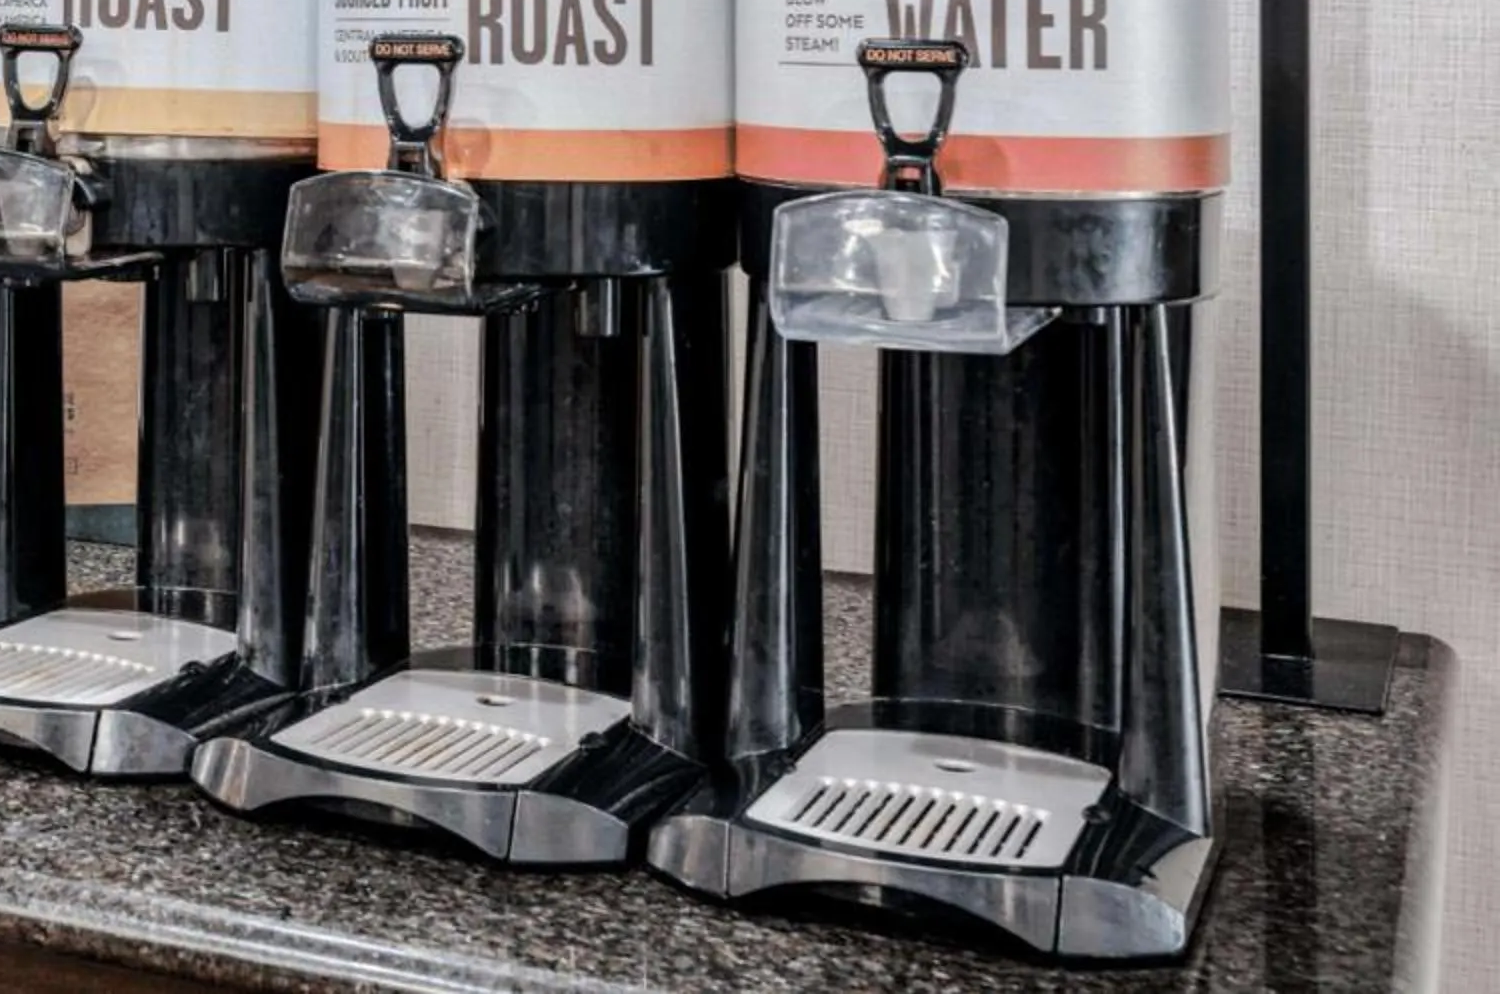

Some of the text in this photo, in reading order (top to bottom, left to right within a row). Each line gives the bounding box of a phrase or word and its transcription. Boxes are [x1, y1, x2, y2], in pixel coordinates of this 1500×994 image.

[785, 14, 865, 30] OFF SOME
[865, 49, 885, 62] DO
[888, 49, 913, 63] NOT
